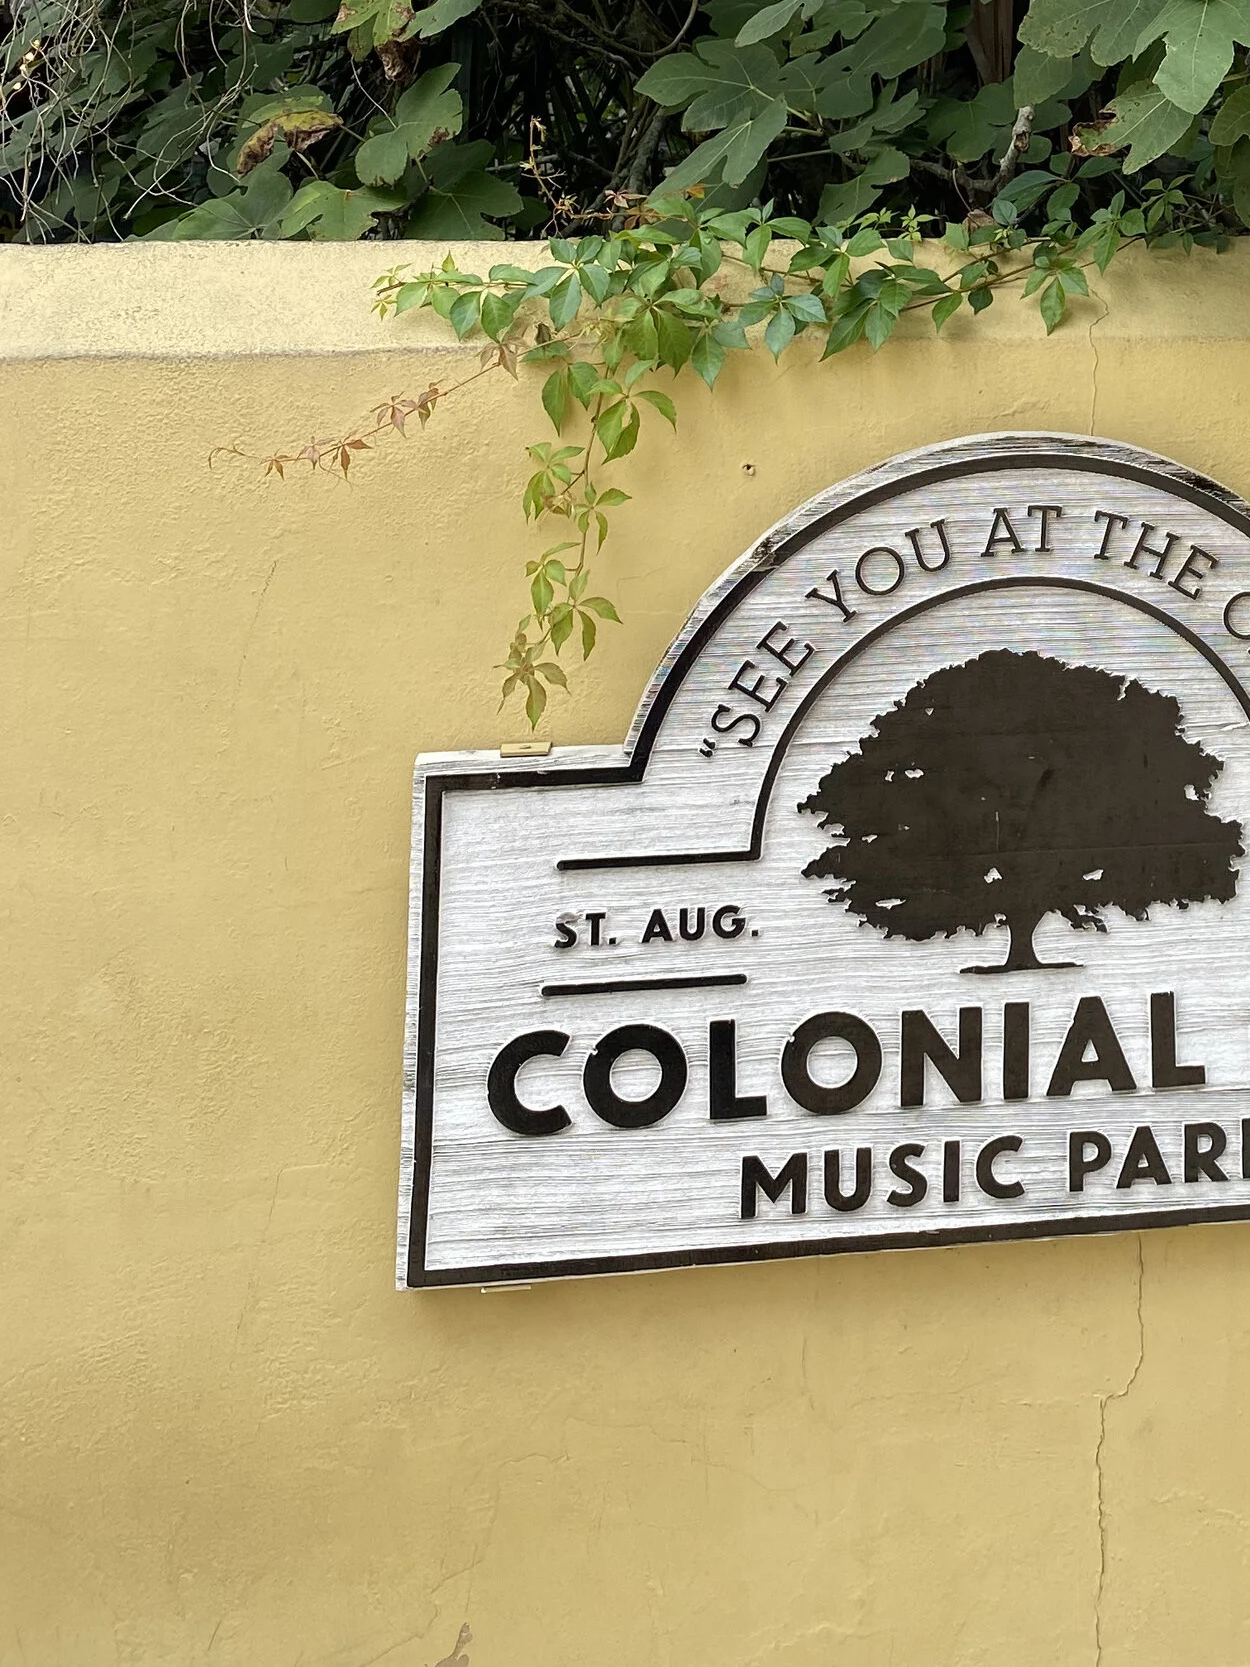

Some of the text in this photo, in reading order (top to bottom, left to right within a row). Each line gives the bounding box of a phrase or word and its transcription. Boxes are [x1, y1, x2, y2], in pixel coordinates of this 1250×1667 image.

[805, 518, 955, 624] YOU
[981, 505, 1063, 558] AT
[1093, 510, 1220, 601] THE
[553, 904, 761, 950] ST. AUG.
[486, 990, 1206, 1139] COLONIAL
[740, 1135, 1026, 1220] MUSIC
